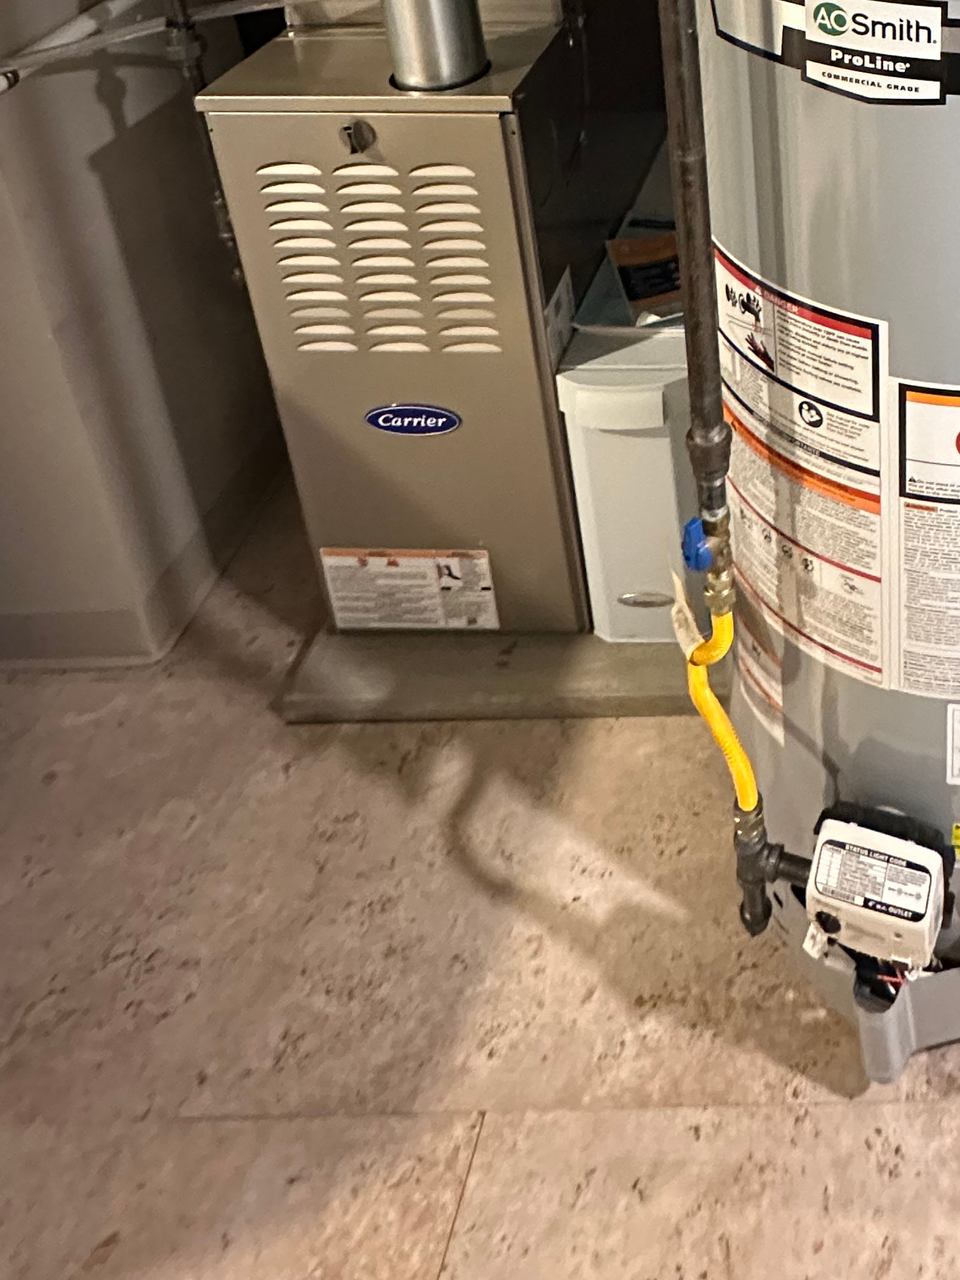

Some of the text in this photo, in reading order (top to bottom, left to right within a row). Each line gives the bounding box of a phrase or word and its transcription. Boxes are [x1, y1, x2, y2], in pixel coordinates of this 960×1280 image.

[852, 12, 932, 44] Smith
[831, 48, 906, 74] ProLine
[821, 71, 921, 94] COMMERCIAL GRADE
[378, 413, 446, 428] Carrier
